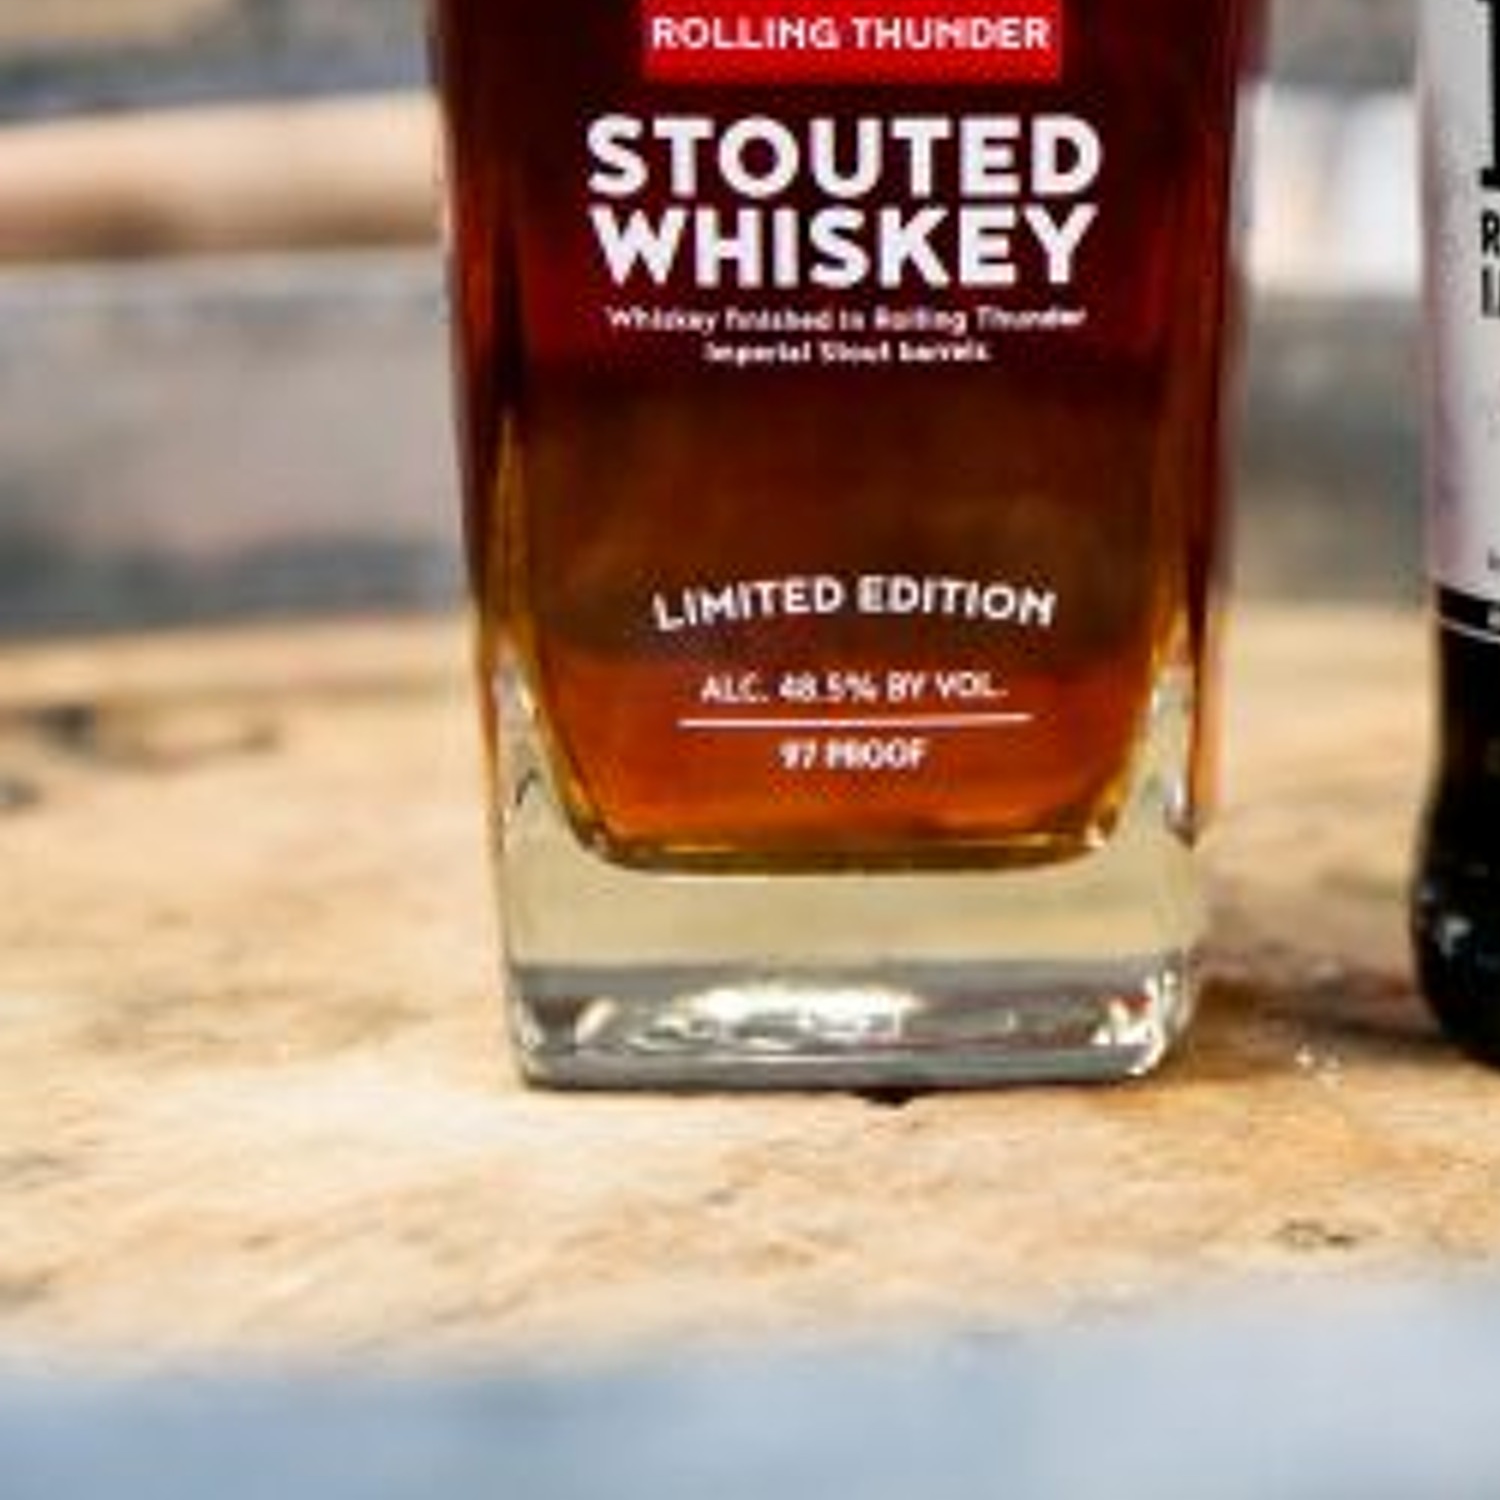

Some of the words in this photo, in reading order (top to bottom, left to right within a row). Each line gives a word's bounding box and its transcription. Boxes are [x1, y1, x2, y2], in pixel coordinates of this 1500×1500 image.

[650, 16, 840, 51] ROLLING
[849, 16, 1052, 51] THUNDER
[586, 113, 1102, 198] STOUTED
[588, 204, 1099, 288] WHISKEY
[605, 306, 718, 337] Whiskey
[653, 574, 843, 632] LIMITED
[856, 574, 1057, 626] EDITION
[701, 671, 768, 704] ALC.
[887, 673, 924, 701] BY
[935, 670, 1007, 699] VOL.
[826, 739, 928, 770] PROOF
